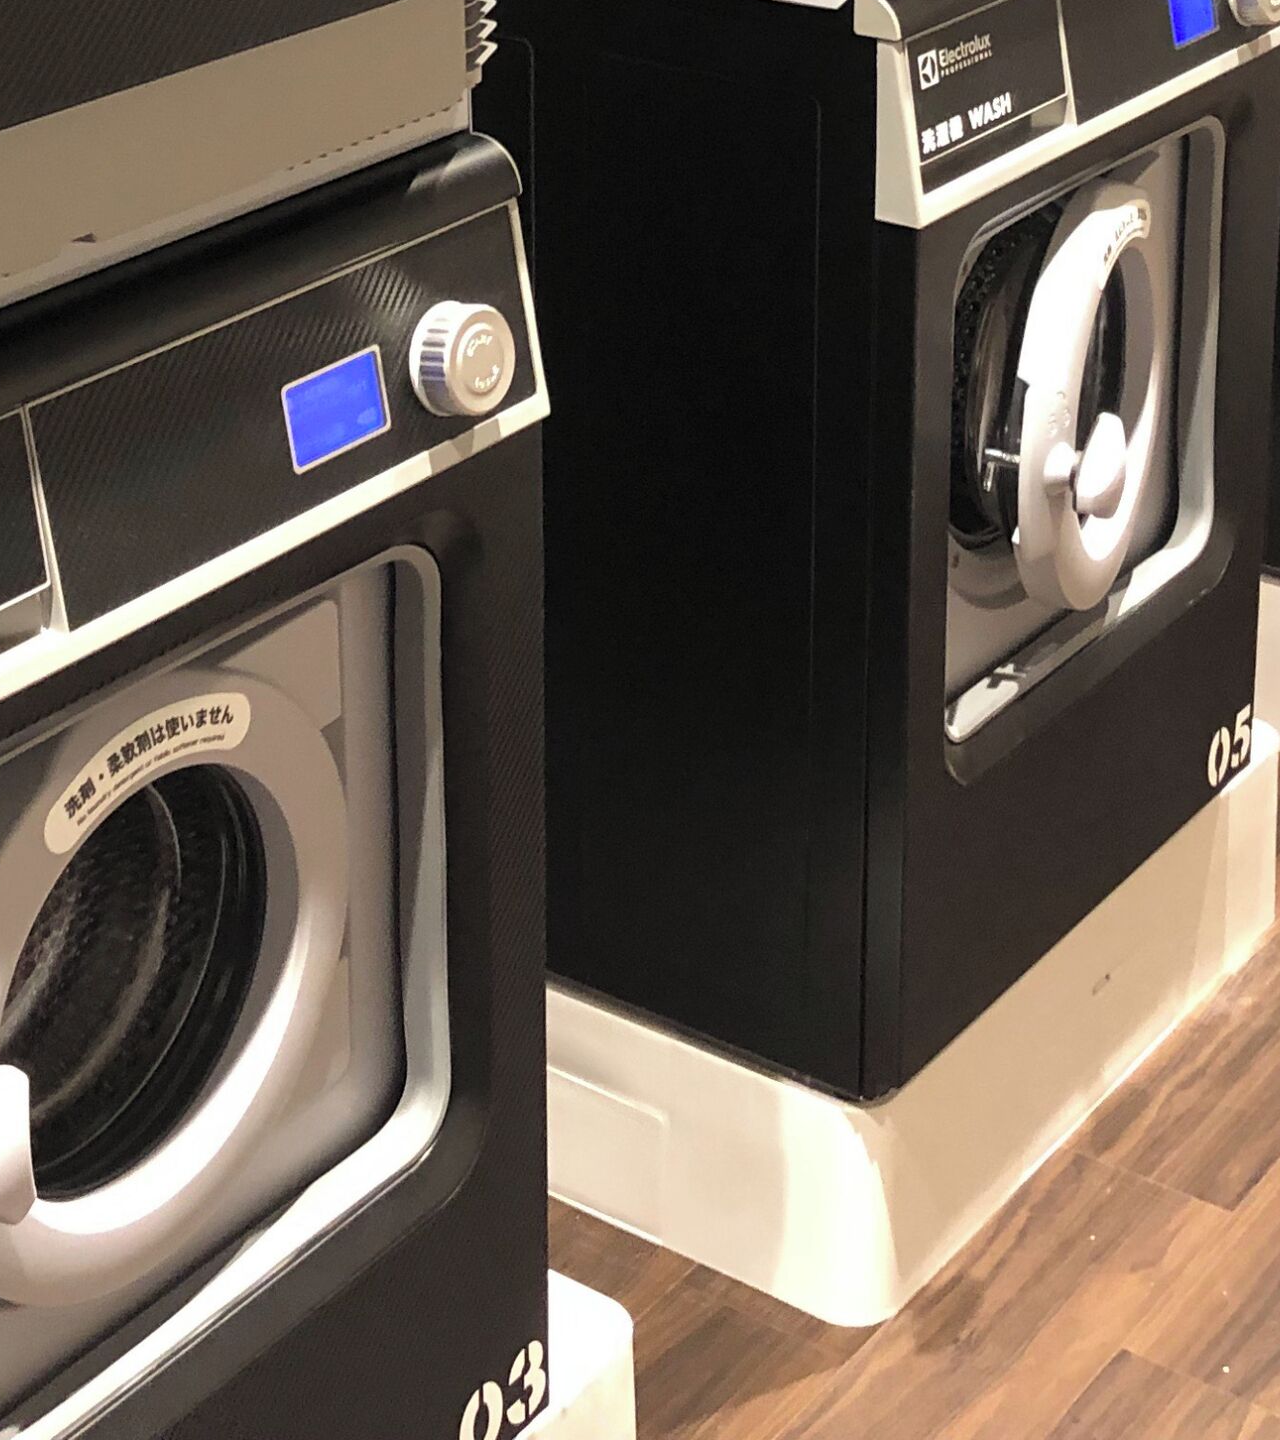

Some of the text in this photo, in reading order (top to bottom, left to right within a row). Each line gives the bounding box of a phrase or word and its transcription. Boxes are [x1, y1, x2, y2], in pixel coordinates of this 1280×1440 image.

[939, 34, 991, 67] Electrolux
[968, 92, 1012, 130] WASH
[1208, 704, 1251, 788] 05
[459, 1340, 546, 1440] 03
